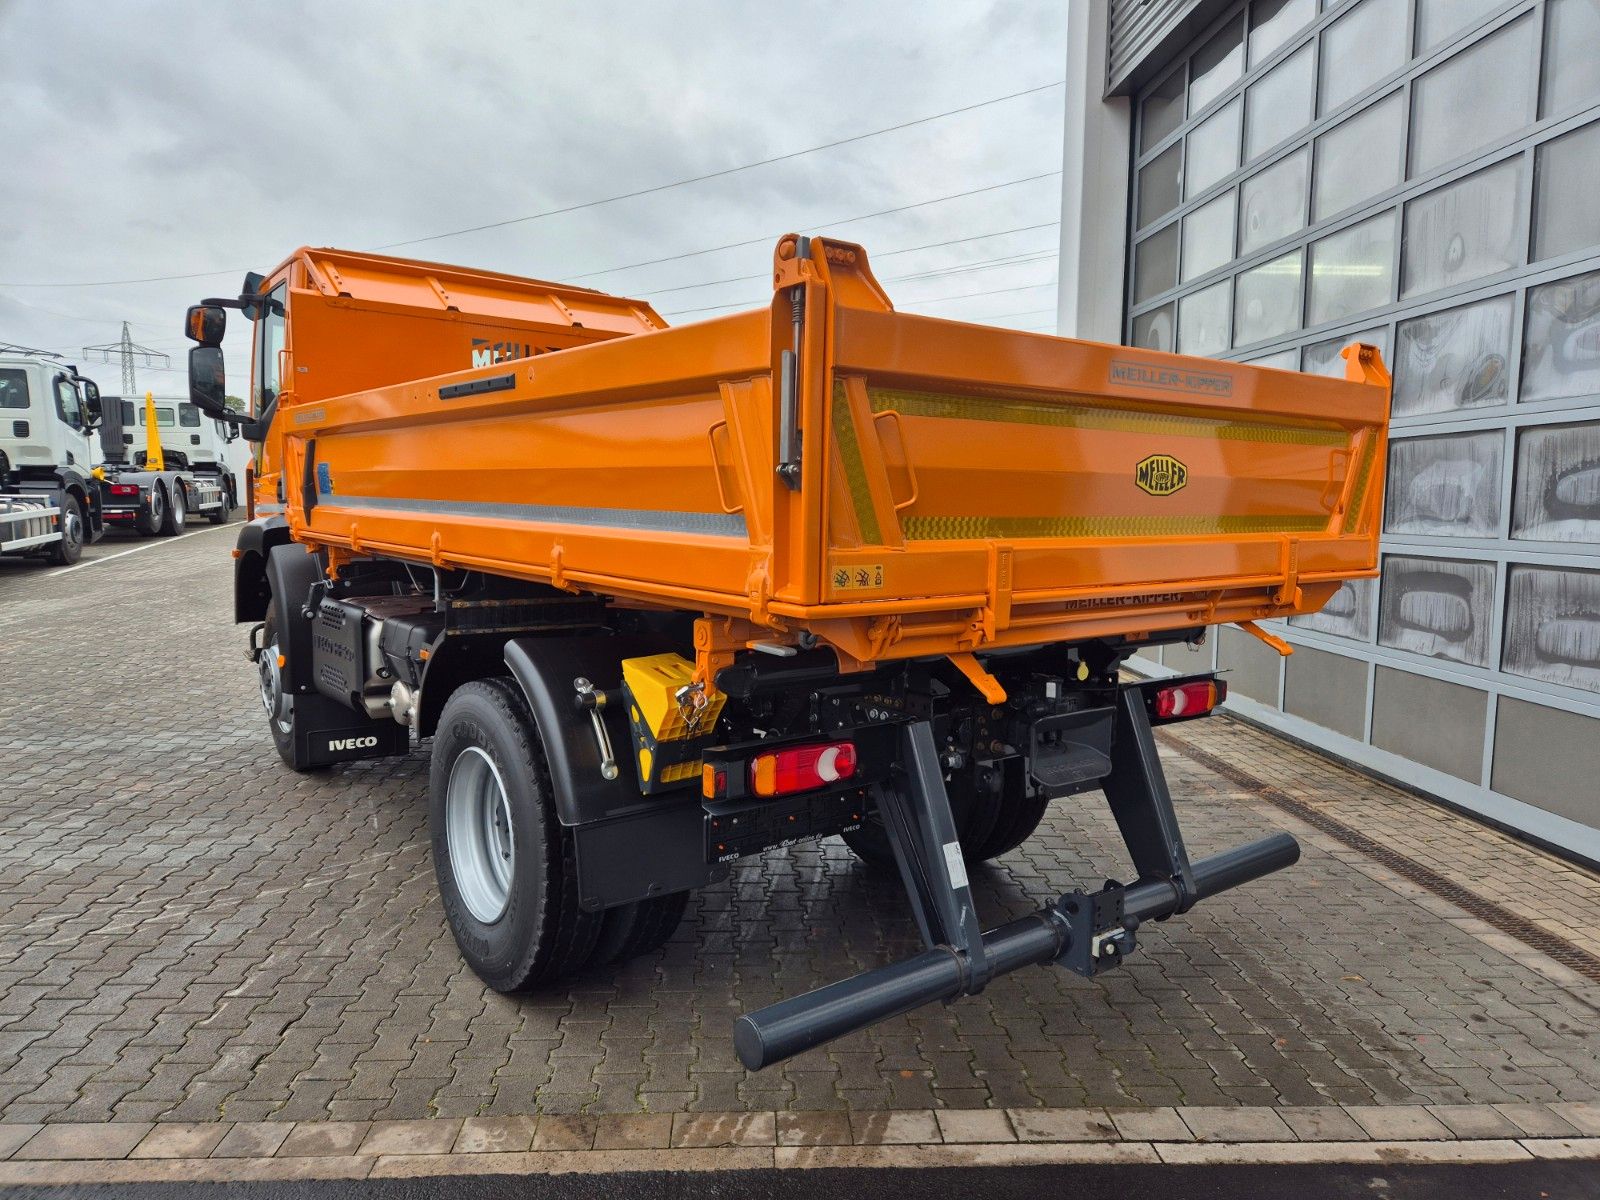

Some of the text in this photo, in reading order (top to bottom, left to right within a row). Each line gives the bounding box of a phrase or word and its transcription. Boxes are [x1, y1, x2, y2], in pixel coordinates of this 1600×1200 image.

[1138, 458, 1187, 492] MEILLER
[328, 735, 378, 752] IVECO
[843, 824, 861, 833] IVECO
[718, 853, 739, 862] IVECO
